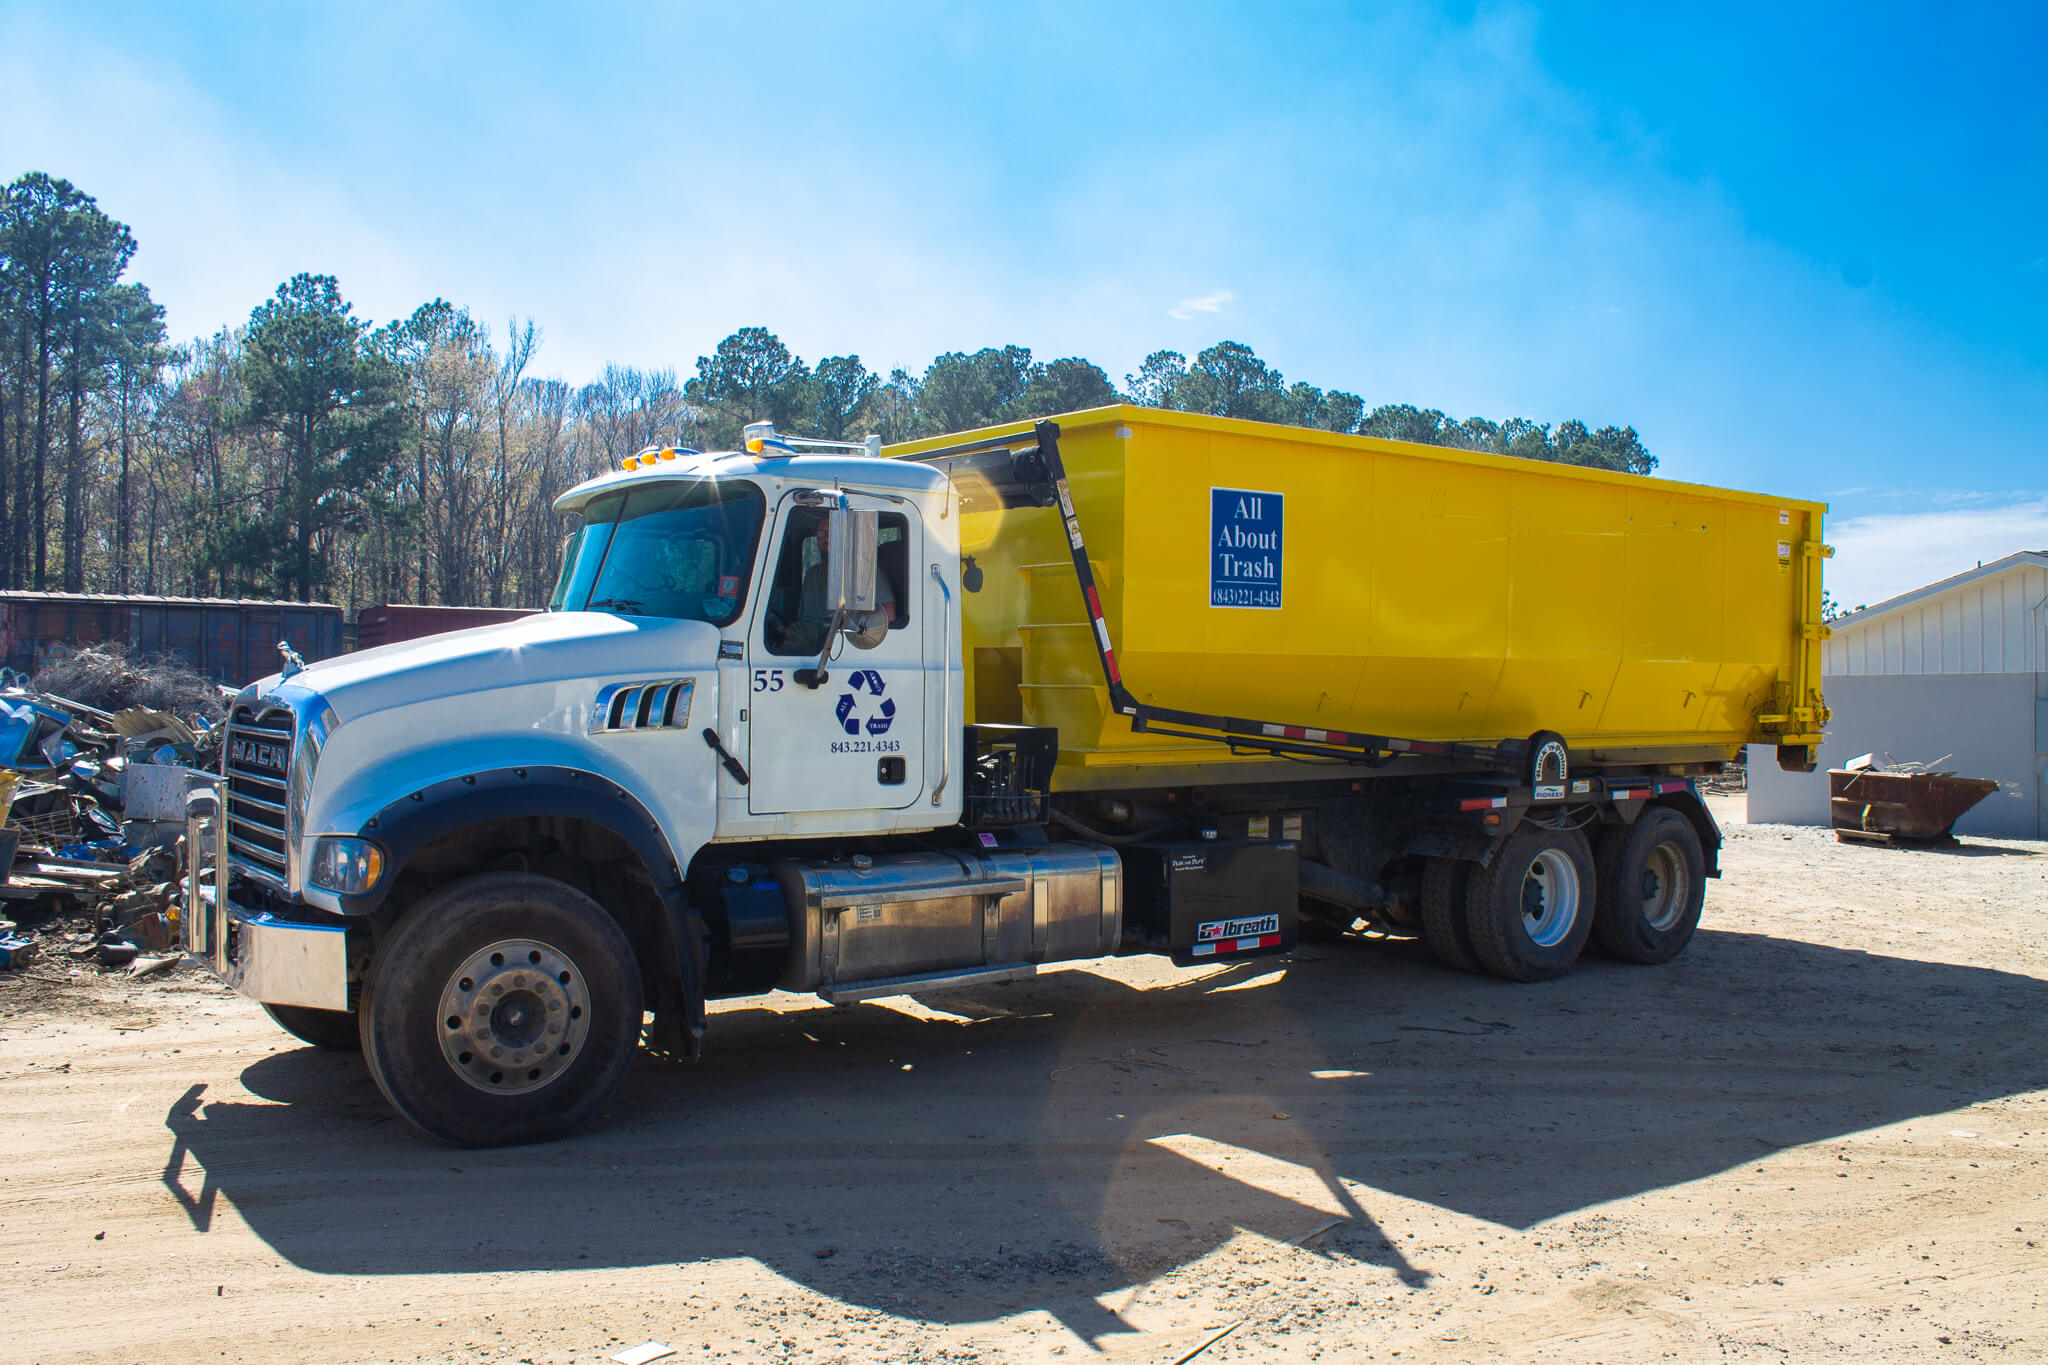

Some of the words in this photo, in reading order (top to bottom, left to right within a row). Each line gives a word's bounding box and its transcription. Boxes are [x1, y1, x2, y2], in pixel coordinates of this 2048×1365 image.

[1234, 495, 1262, 521] All
[1217, 524, 1278, 550] About
[1218, 553, 1275, 579] Trash
[1213, 588, 1280, 606] (843)221-4343
[753, 669, 785, 693] 55
[839, 701, 849, 713] ALL
[868, 671, 883, 693] ABOUT
[231, 739, 286, 769] MACK
[830, 740, 901, 754] 843.221.4343
